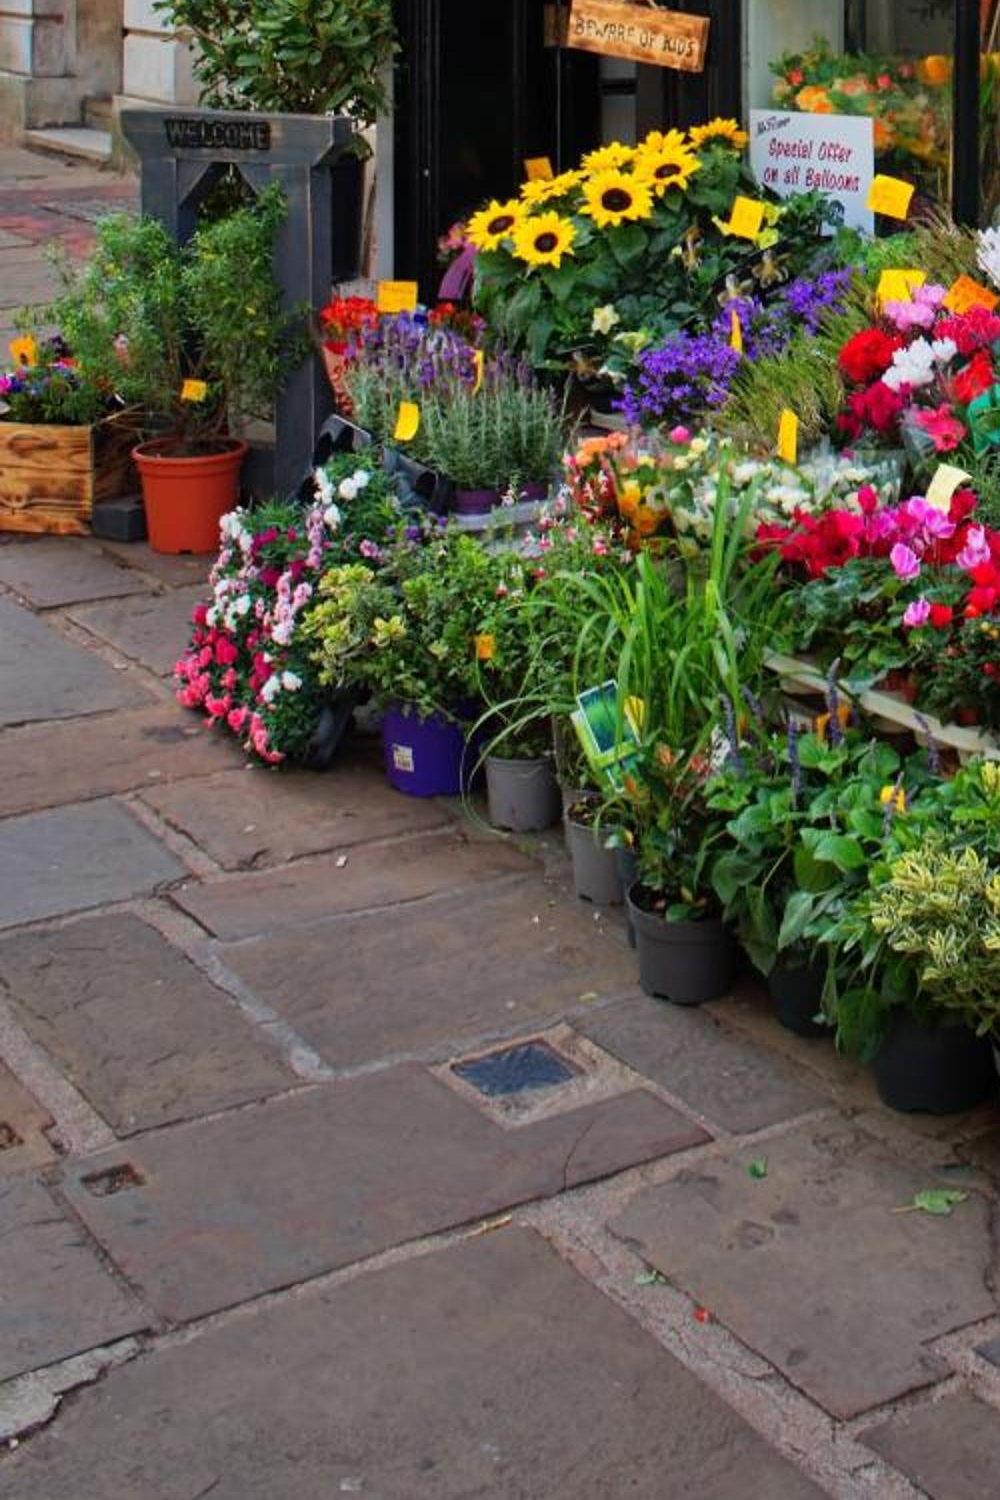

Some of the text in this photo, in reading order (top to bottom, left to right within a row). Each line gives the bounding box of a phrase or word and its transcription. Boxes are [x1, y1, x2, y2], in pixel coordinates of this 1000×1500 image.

[574, 16, 695, 58] BEWARE OF KIDS
[166, 118, 271, 150] WELCOME
[768, 138, 854, 163] Special Offer
[764, 166, 860, 193] on all Balloons
